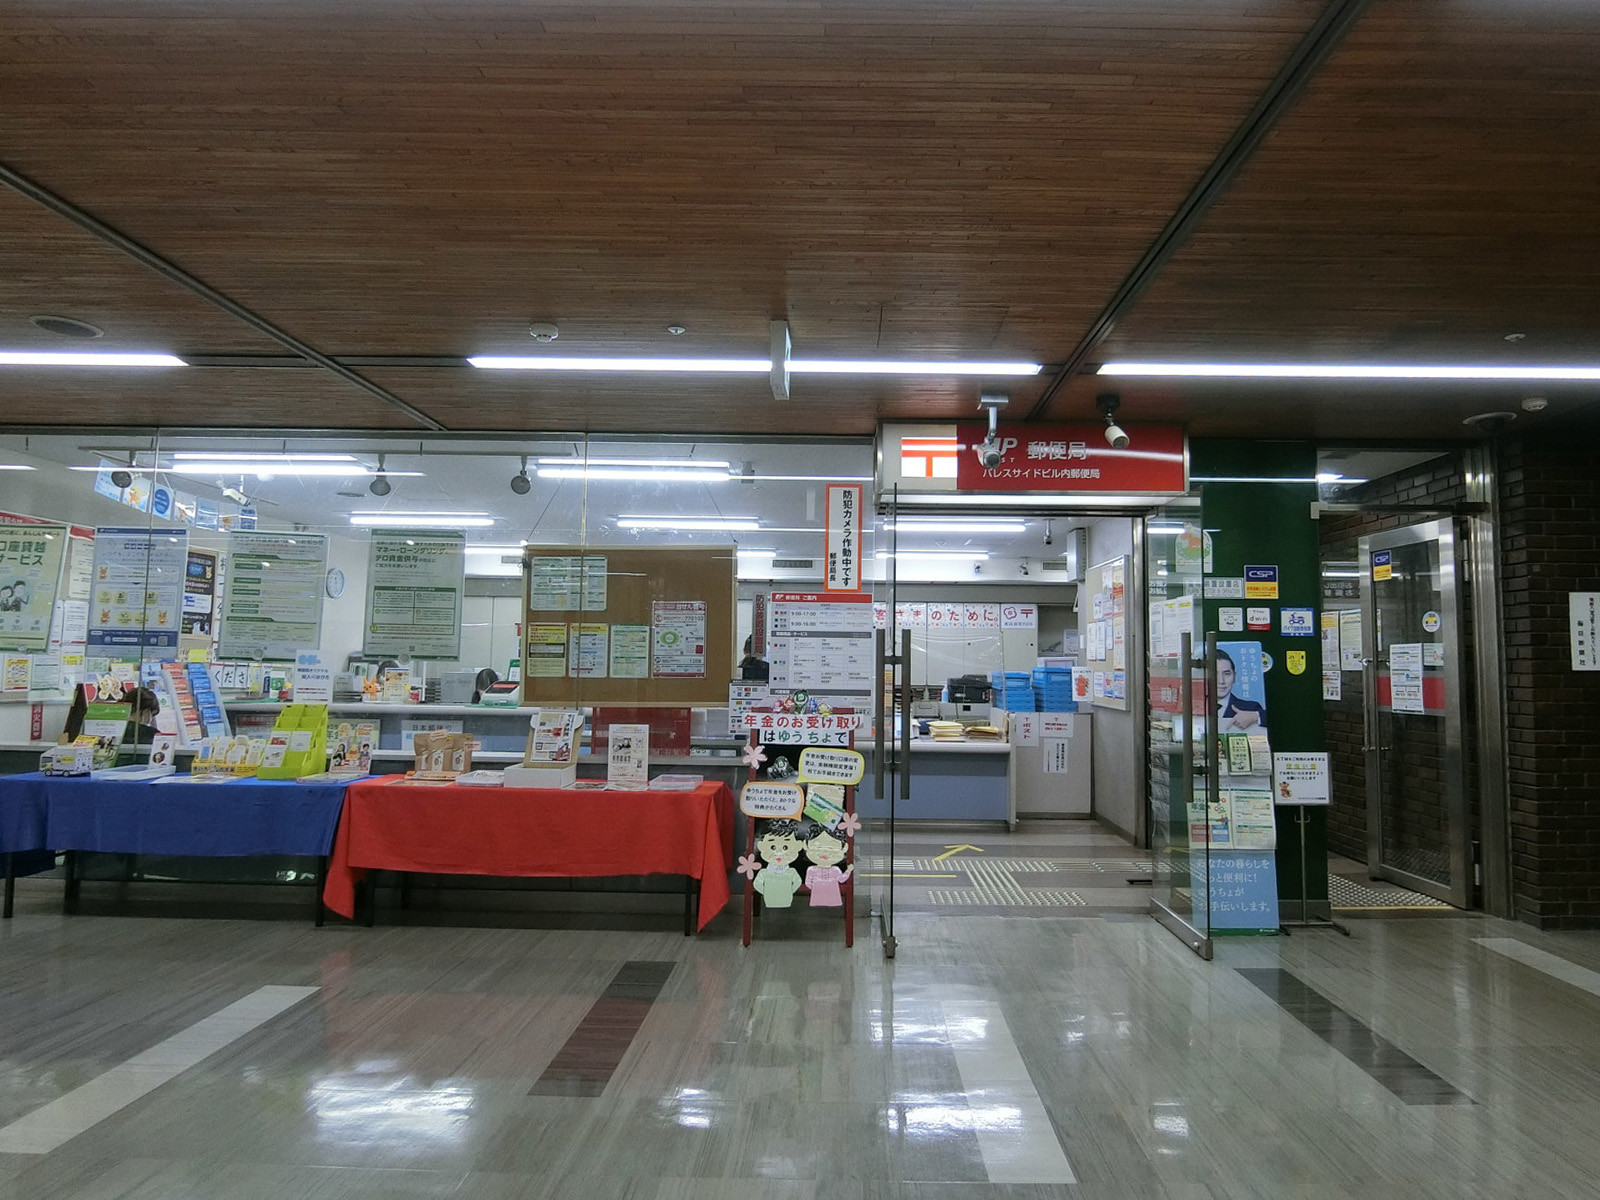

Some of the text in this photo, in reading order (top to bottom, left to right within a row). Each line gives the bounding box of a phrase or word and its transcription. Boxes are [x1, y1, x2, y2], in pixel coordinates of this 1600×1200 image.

[1027, 440, 1087, 460] 郵便局
[982, 468, 1100, 479] パレスサイドビル内郵便局
[842, 489, 853, 587] 防犯カメラ作動中です
[829, 552, 837, 582] 郵便局長
[1248, 570, 1274, 578] CSP
[744, 714, 861, 729] 年金のお受け取り
[763, 730, 847, 743] はゆうちょで
